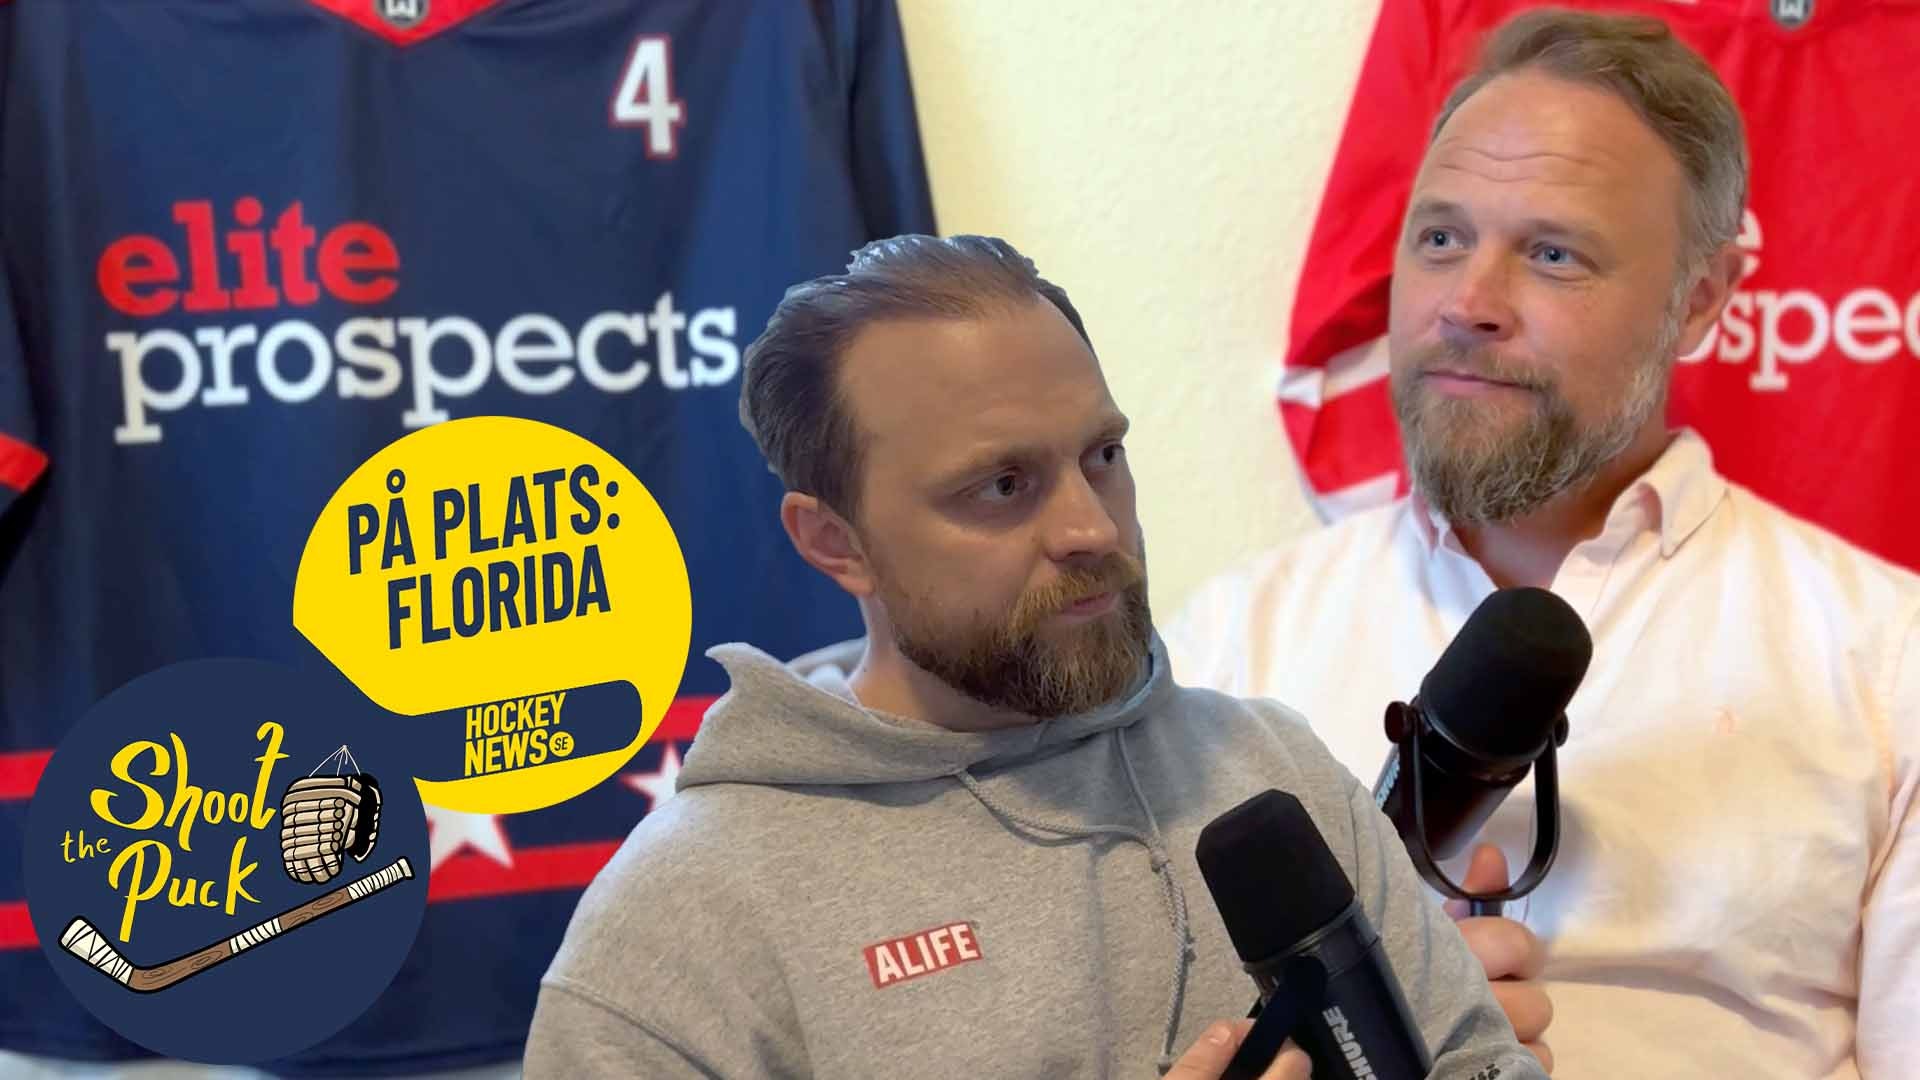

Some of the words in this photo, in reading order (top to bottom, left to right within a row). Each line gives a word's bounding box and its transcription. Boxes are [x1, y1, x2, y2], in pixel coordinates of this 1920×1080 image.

[611, 34, 684, 159] 4
[97, 197, 399, 317] elite
[107, 291, 741, 445] prospects
[875, 923, 979, 984] ALIFE
